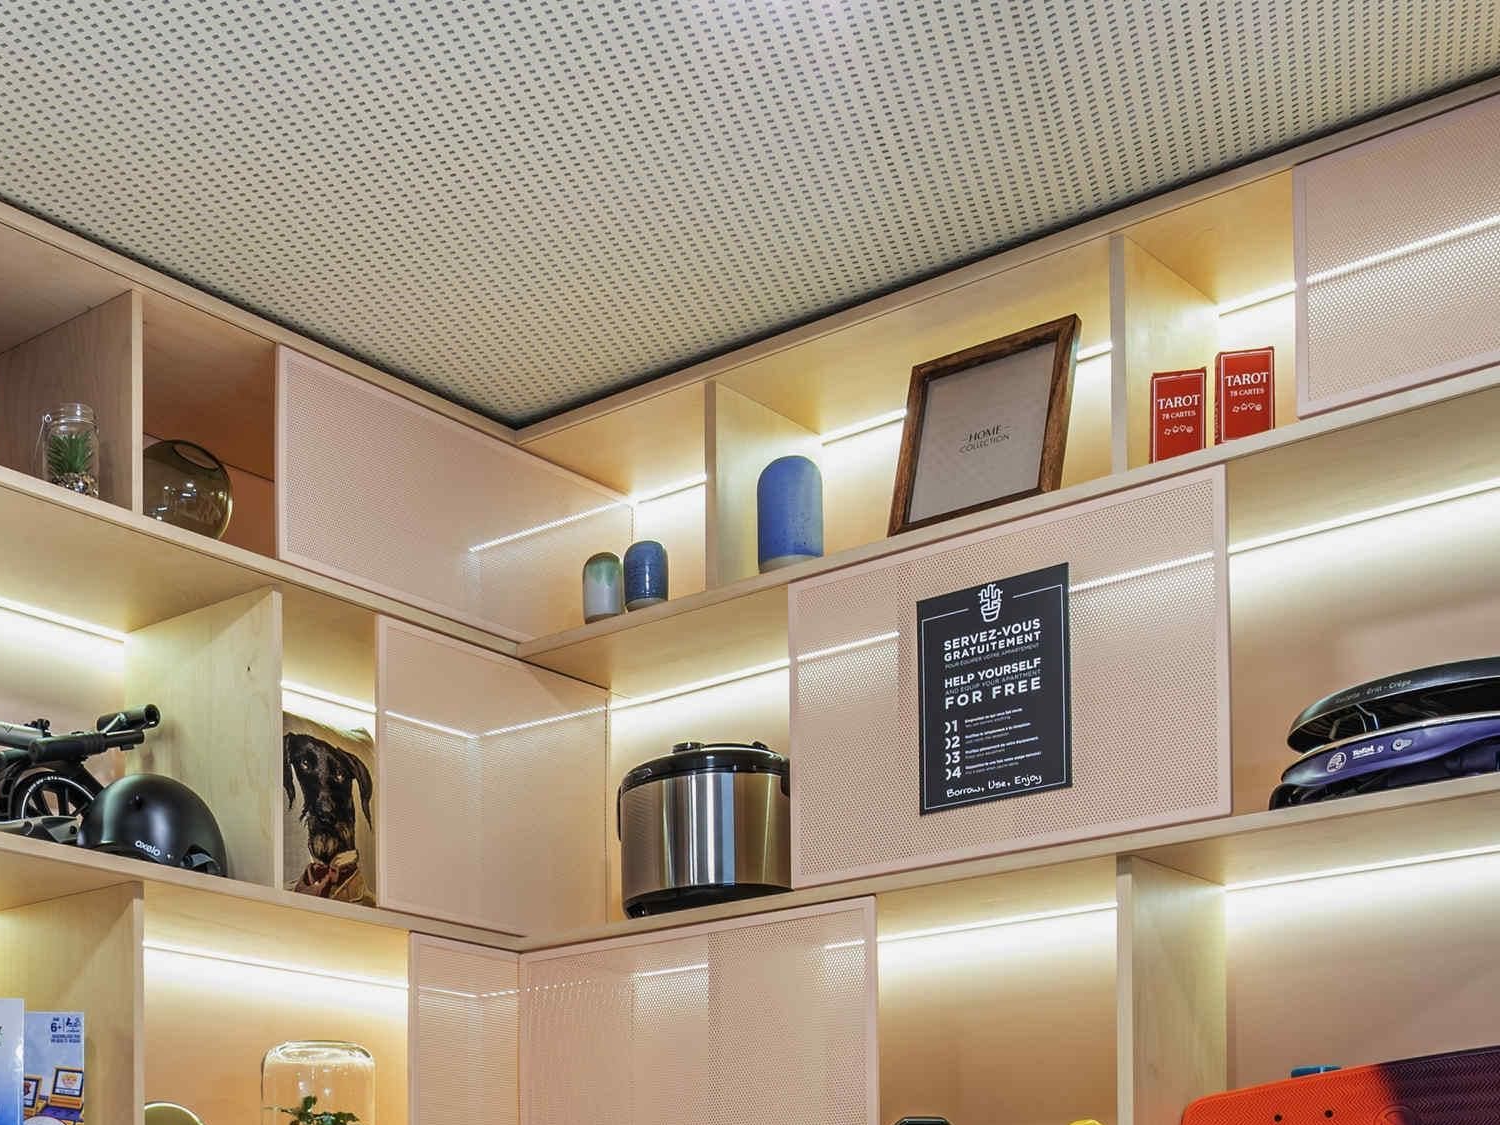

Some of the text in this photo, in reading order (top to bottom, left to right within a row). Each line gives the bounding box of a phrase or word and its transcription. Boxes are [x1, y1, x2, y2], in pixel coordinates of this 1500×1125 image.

[1225, 371, 1269, 387] TAROT
[1238, 387, 1265, 396] CARTES
[1157, 394, 1201, 410] TAROT
[1170, 410, 1197, 419] CARTES
[944, 618, 1041, 651] SERVEZ-VOUS
[944, 631, 1041, 662] GRATUITEMENT
[944, 657, 1041, 689] HELP YOURSELF
[945, 676, 1041, 710] FOR FREE
[1014, 774, 1043, 787] Enjoy
